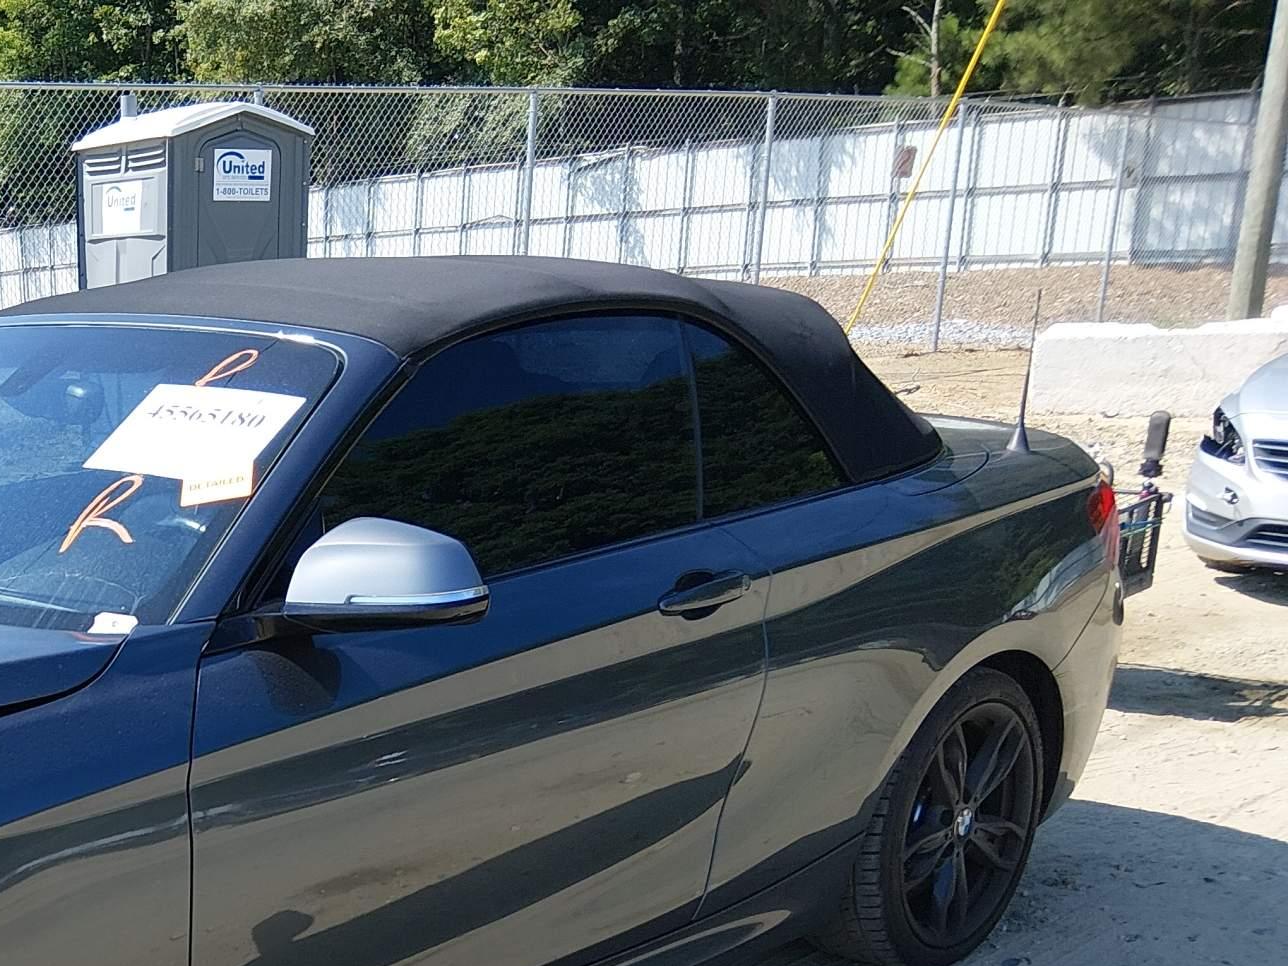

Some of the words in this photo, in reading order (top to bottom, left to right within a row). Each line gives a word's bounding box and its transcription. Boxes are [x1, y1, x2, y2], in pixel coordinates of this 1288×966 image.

[223, 159, 265, 175] United
[216, 187, 269, 196] 1-800-TOILETS
[107, 193, 137, 208] United
[147, 404, 267, 428] 45565180
